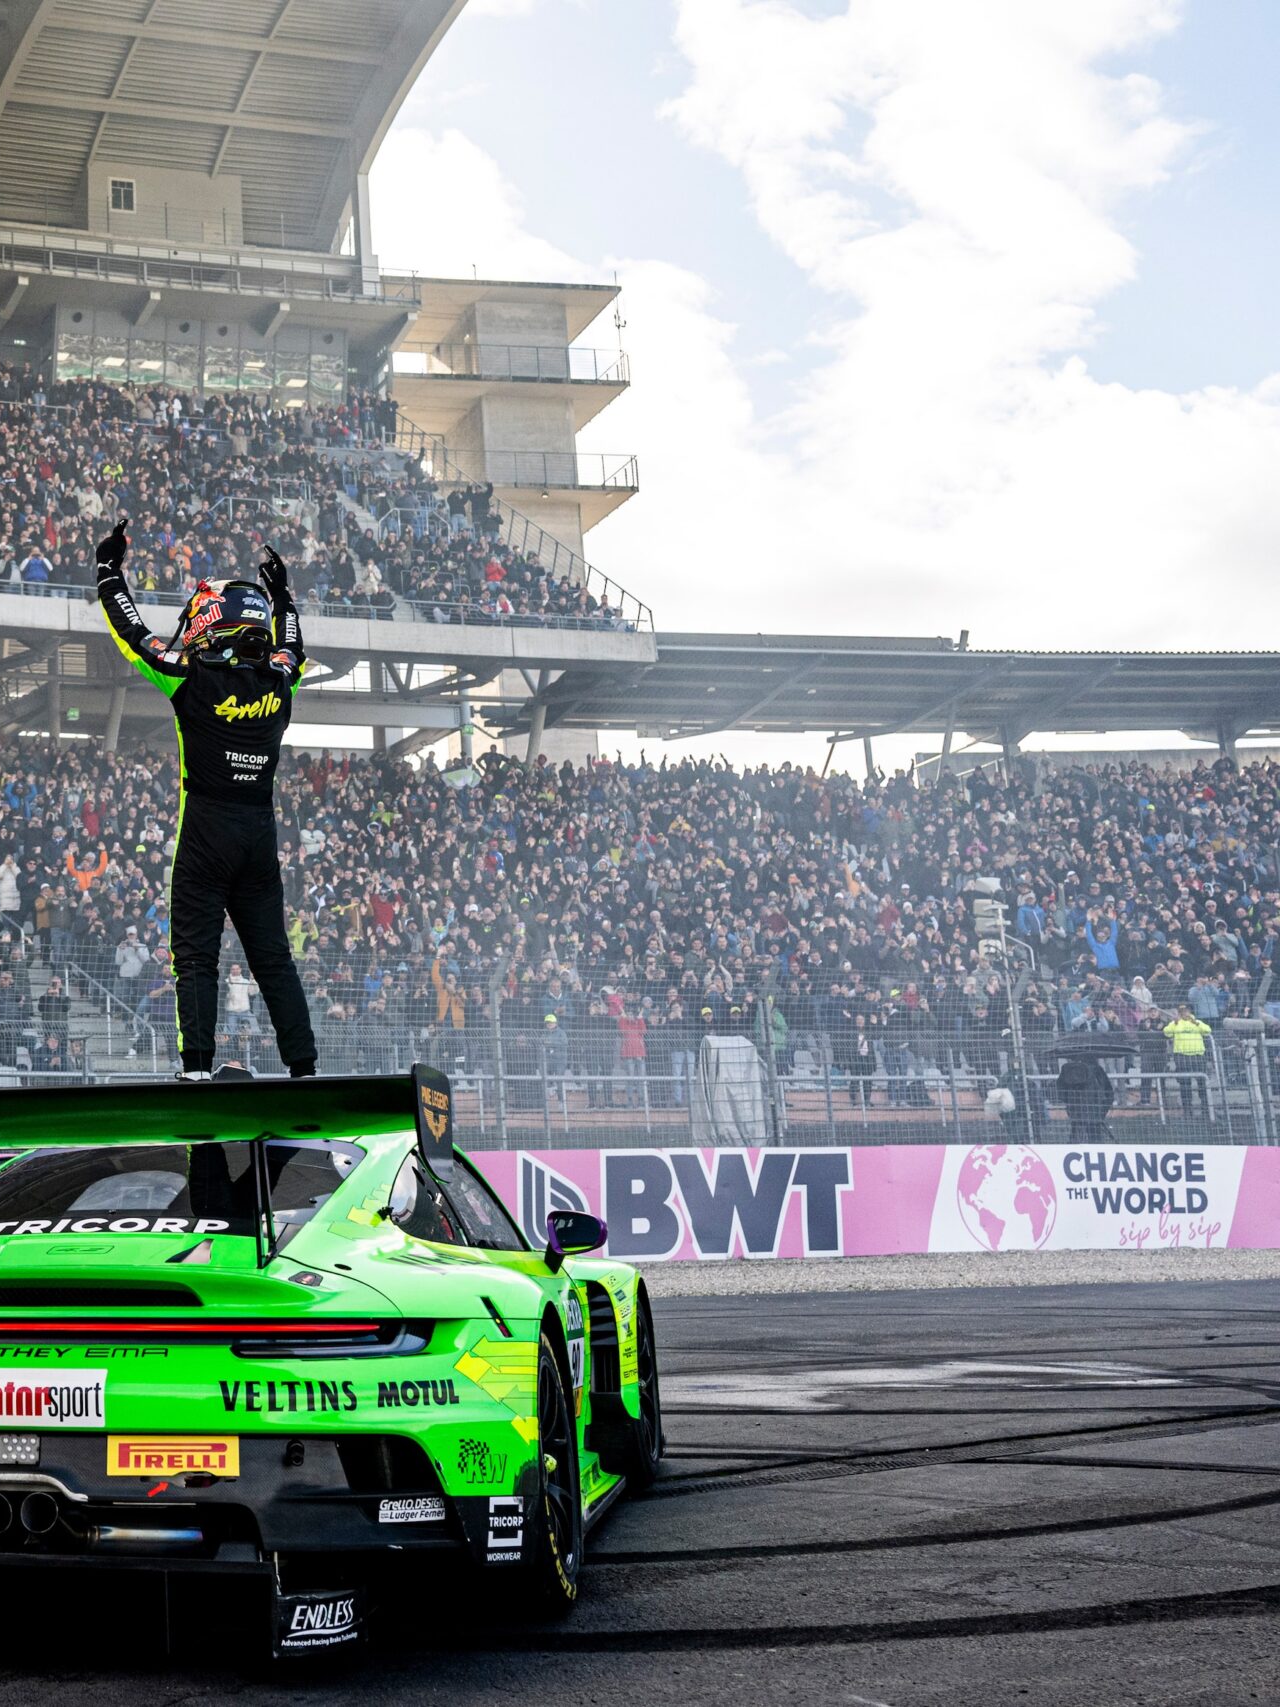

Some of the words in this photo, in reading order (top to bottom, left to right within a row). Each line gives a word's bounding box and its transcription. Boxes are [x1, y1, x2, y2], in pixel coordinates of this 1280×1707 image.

[195, 603, 222, 631] Bull
[241, 609, 266, 620] 90
[213, 691, 281, 722] Grello
[225, 751, 269, 764] TRICORP
[231, 762, 262, 770] WORKWEAR
[1063, 1152, 1206, 1183] CHANGE
[605, 1153, 850, 1257] BWT
[1066, 1187, 1089, 1200] THE
[1092, 1187, 1208, 1214] WORLD
[1119, 1221, 1150, 1249] sip
[1159, 1203, 1181, 1249] by
[1188, 1216, 1221, 1249] sip
[84, 1347, 169, 1358] EMA
[218, 1380, 358, 1412] VELTINS
[377, 1379, 460, 1408] MOTUL
[118, 1442, 228, 1469] PIRELLI
[466, 1453, 507, 1483] KW
[390, 1511, 419, 1521] Ludger
[489, 1516, 523, 1527] TRICORP
[487, 1552, 521, 1561] WORKWEAR
[290, 1598, 354, 1630] ENDLESS
[281, 1639, 311, 1647] Advanced
